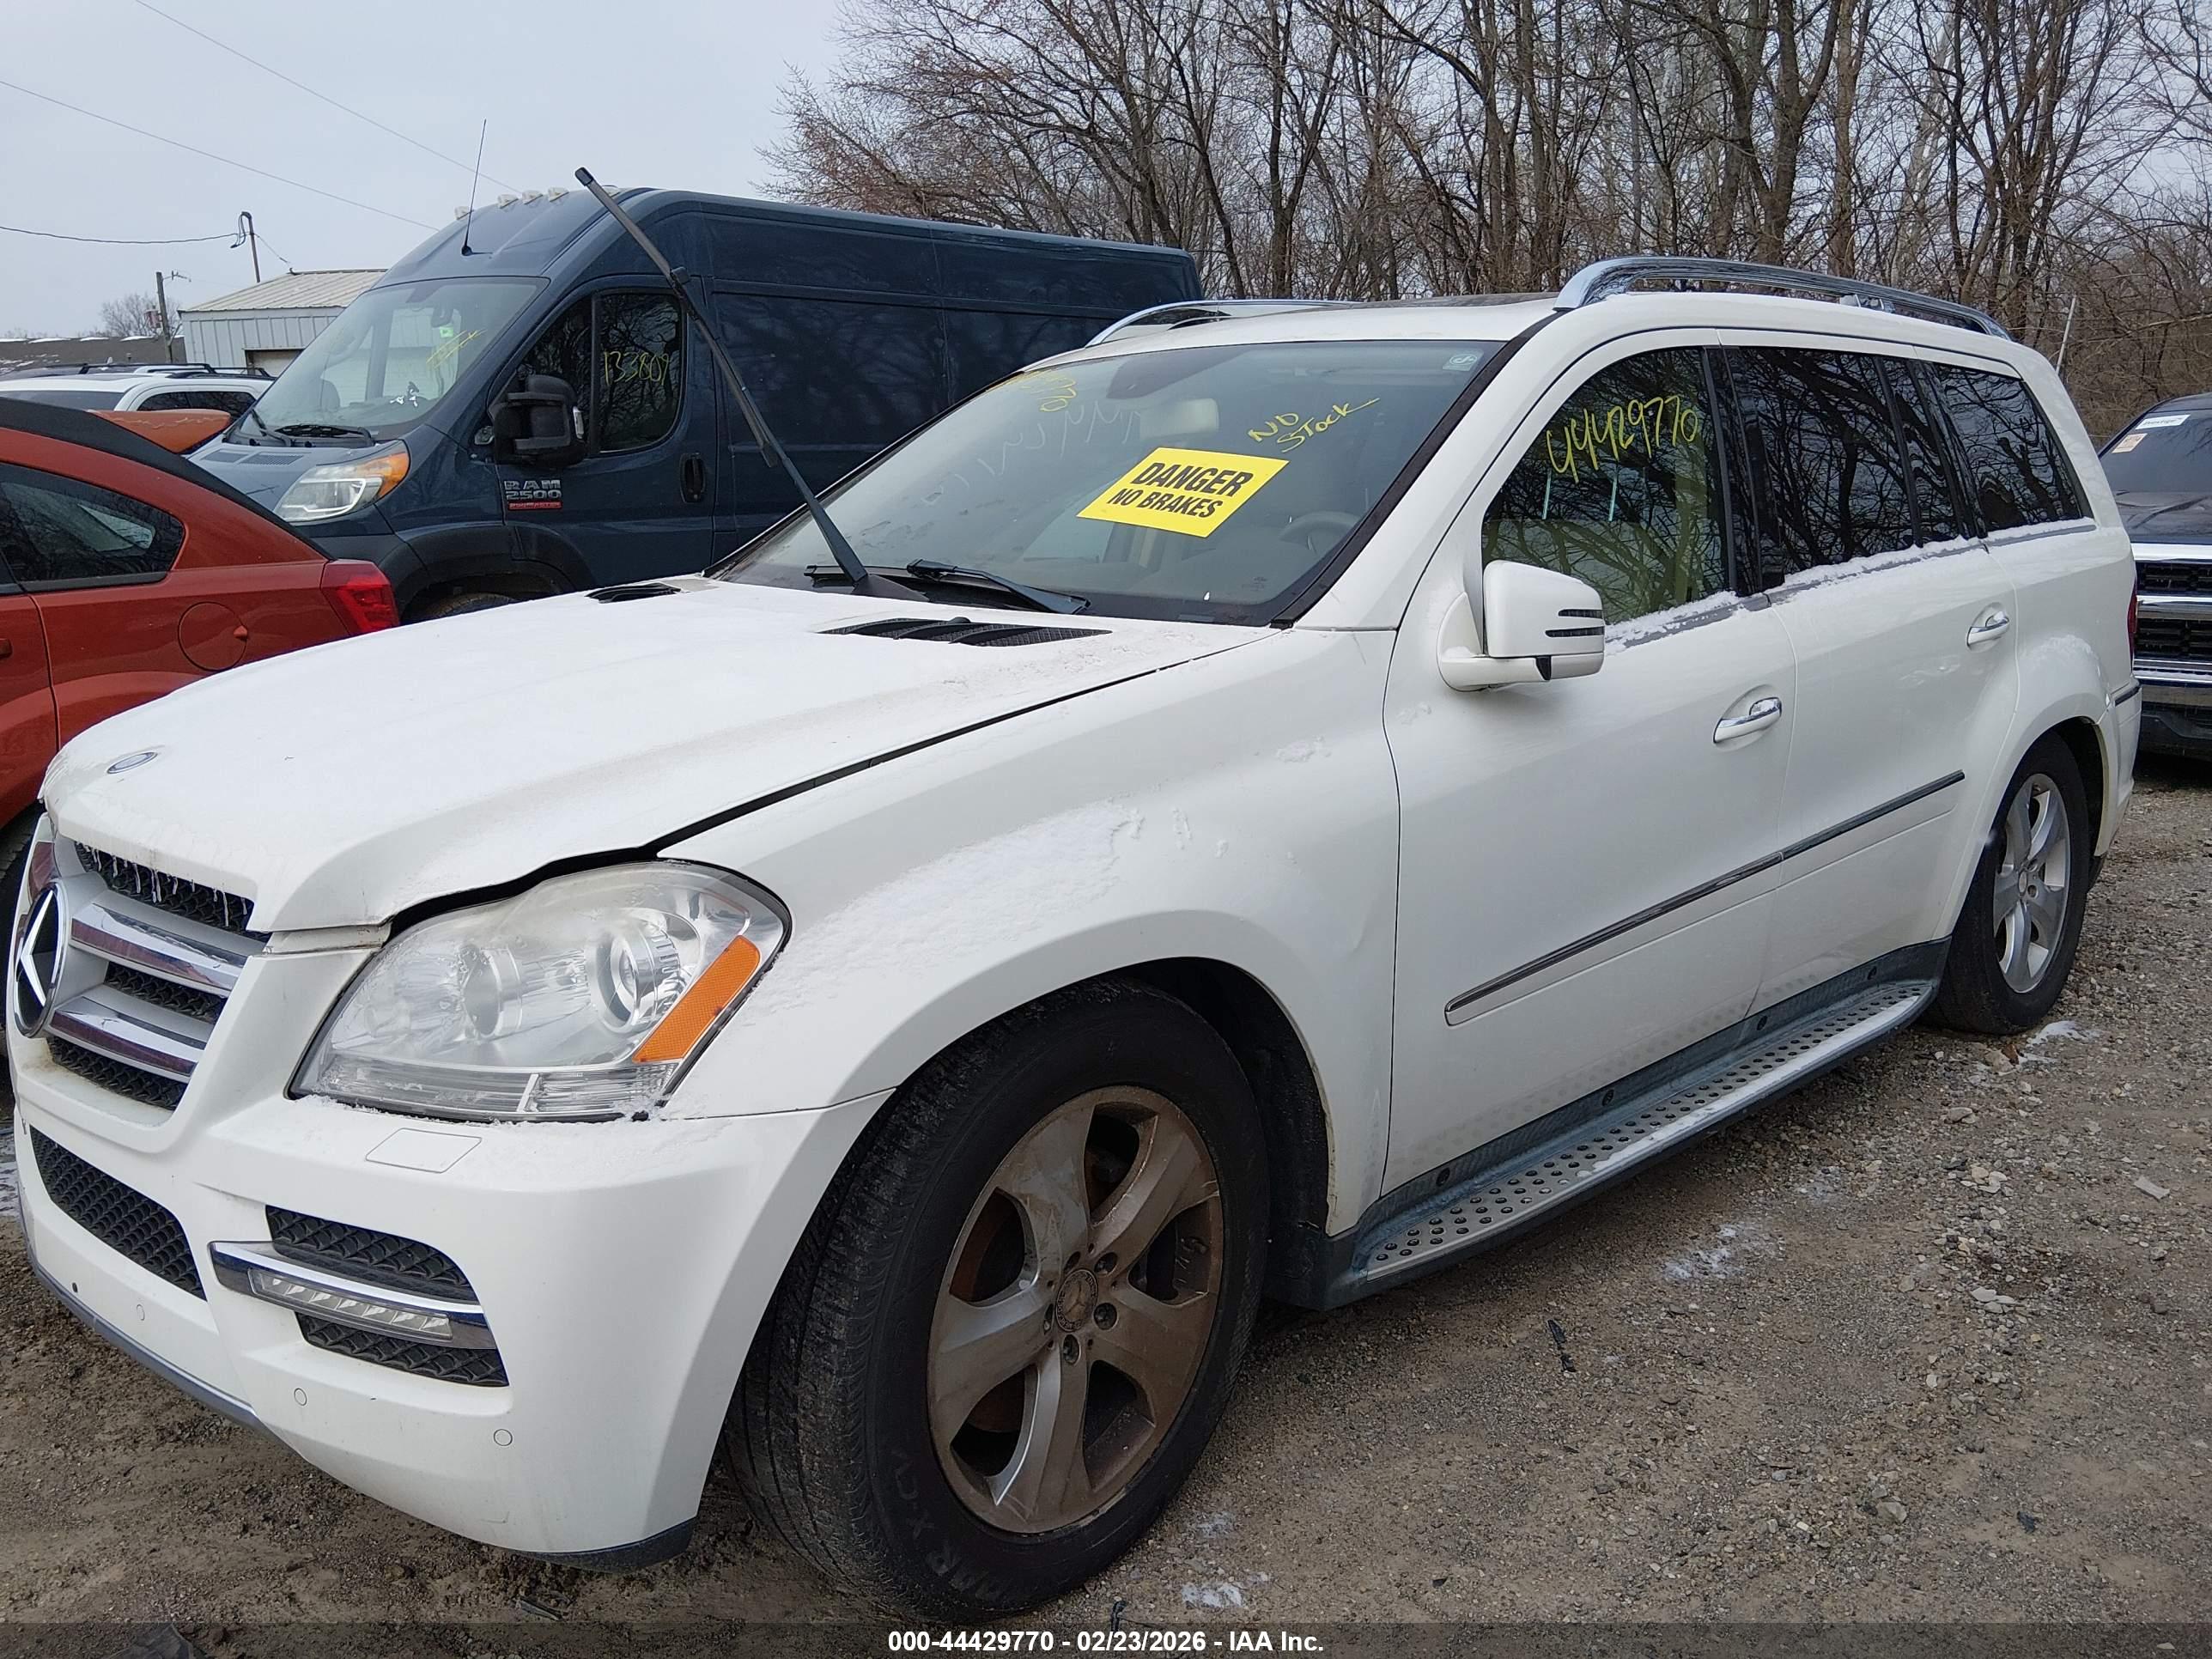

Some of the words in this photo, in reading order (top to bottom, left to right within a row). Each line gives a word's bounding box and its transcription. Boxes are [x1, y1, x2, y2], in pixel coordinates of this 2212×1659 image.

[1547, 396, 1698, 484] 44429770
[503, 479, 562, 490] RAM
[1130, 462, 1255, 497] DANGER
[505, 489, 562, 501] 2500
[1106, 488, 1144, 506] NO
[1136, 491, 1224, 518] BRAKES
